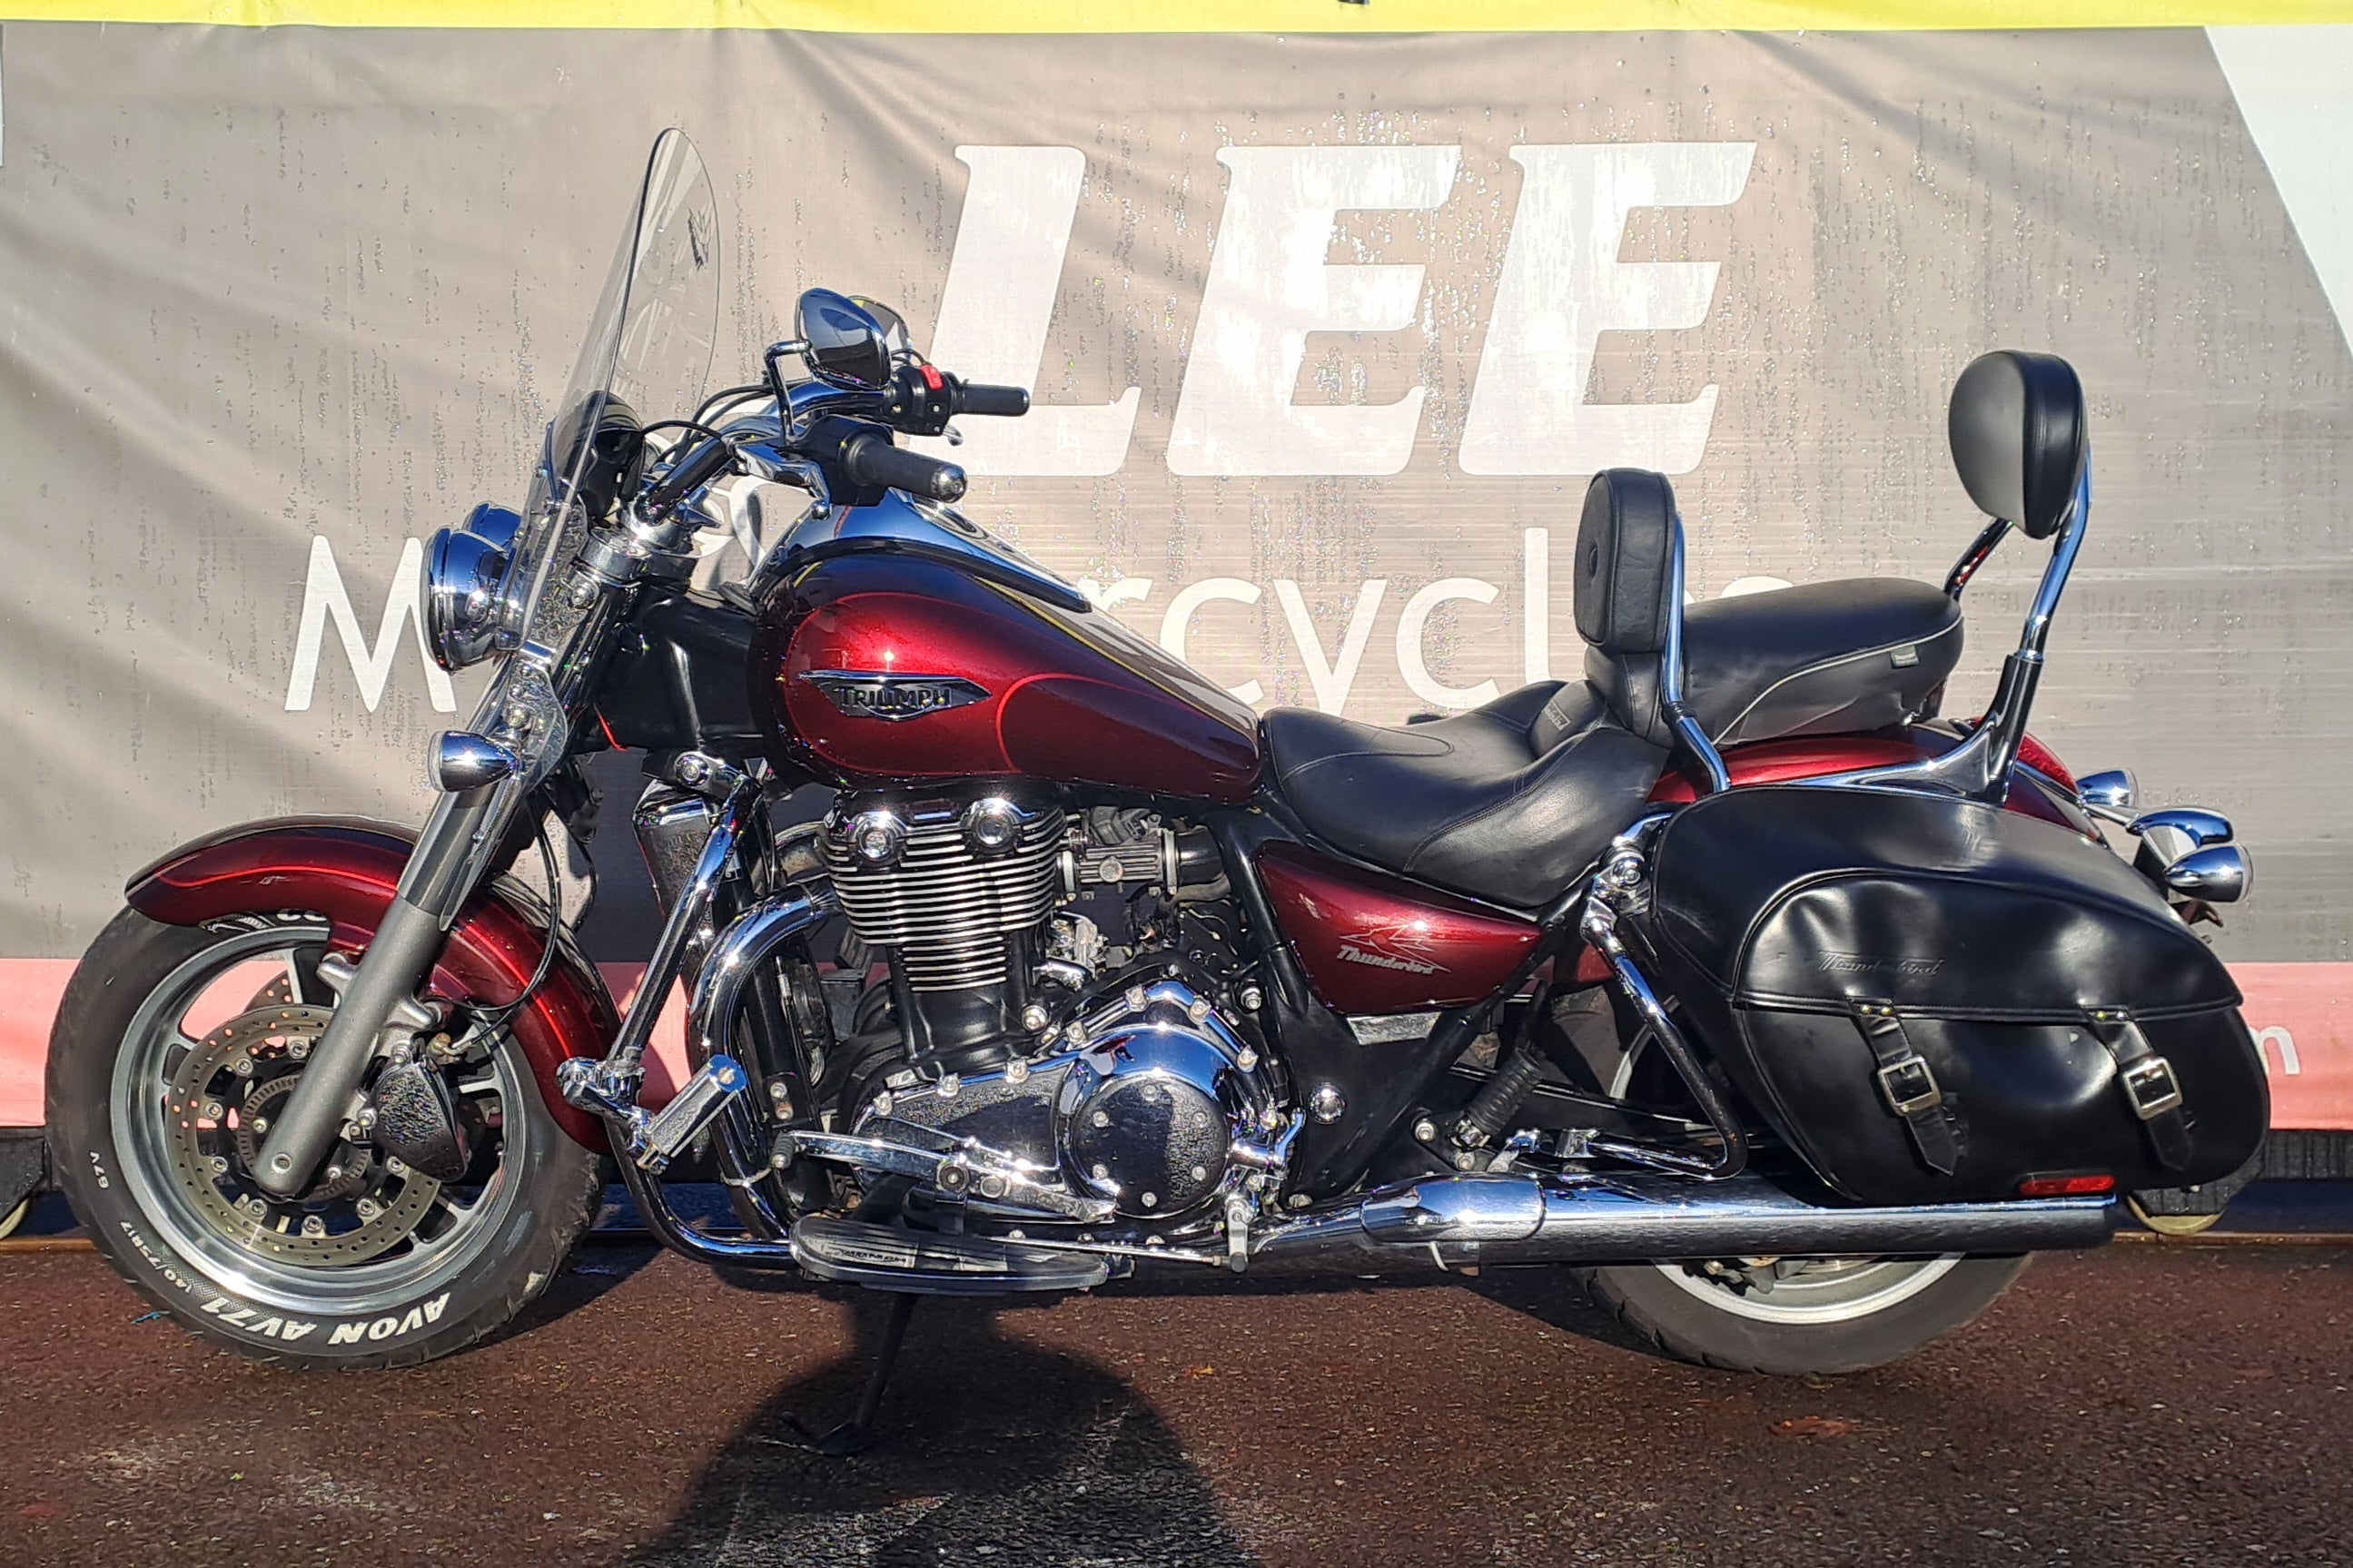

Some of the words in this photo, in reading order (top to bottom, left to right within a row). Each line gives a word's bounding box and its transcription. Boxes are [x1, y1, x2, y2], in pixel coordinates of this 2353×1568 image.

[907, 141, 1757, 477] LEE
[835, 685, 952, 709] TRIUMPH
[1337, 944, 1435, 975] Thunderbird
[89, 1151, 110, 1189] 67V
[120, 1220, 193, 1294] 140/75R17
[200, 1297, 317, 1341] AV71
[327, 1292, 451, 1345] AVON
